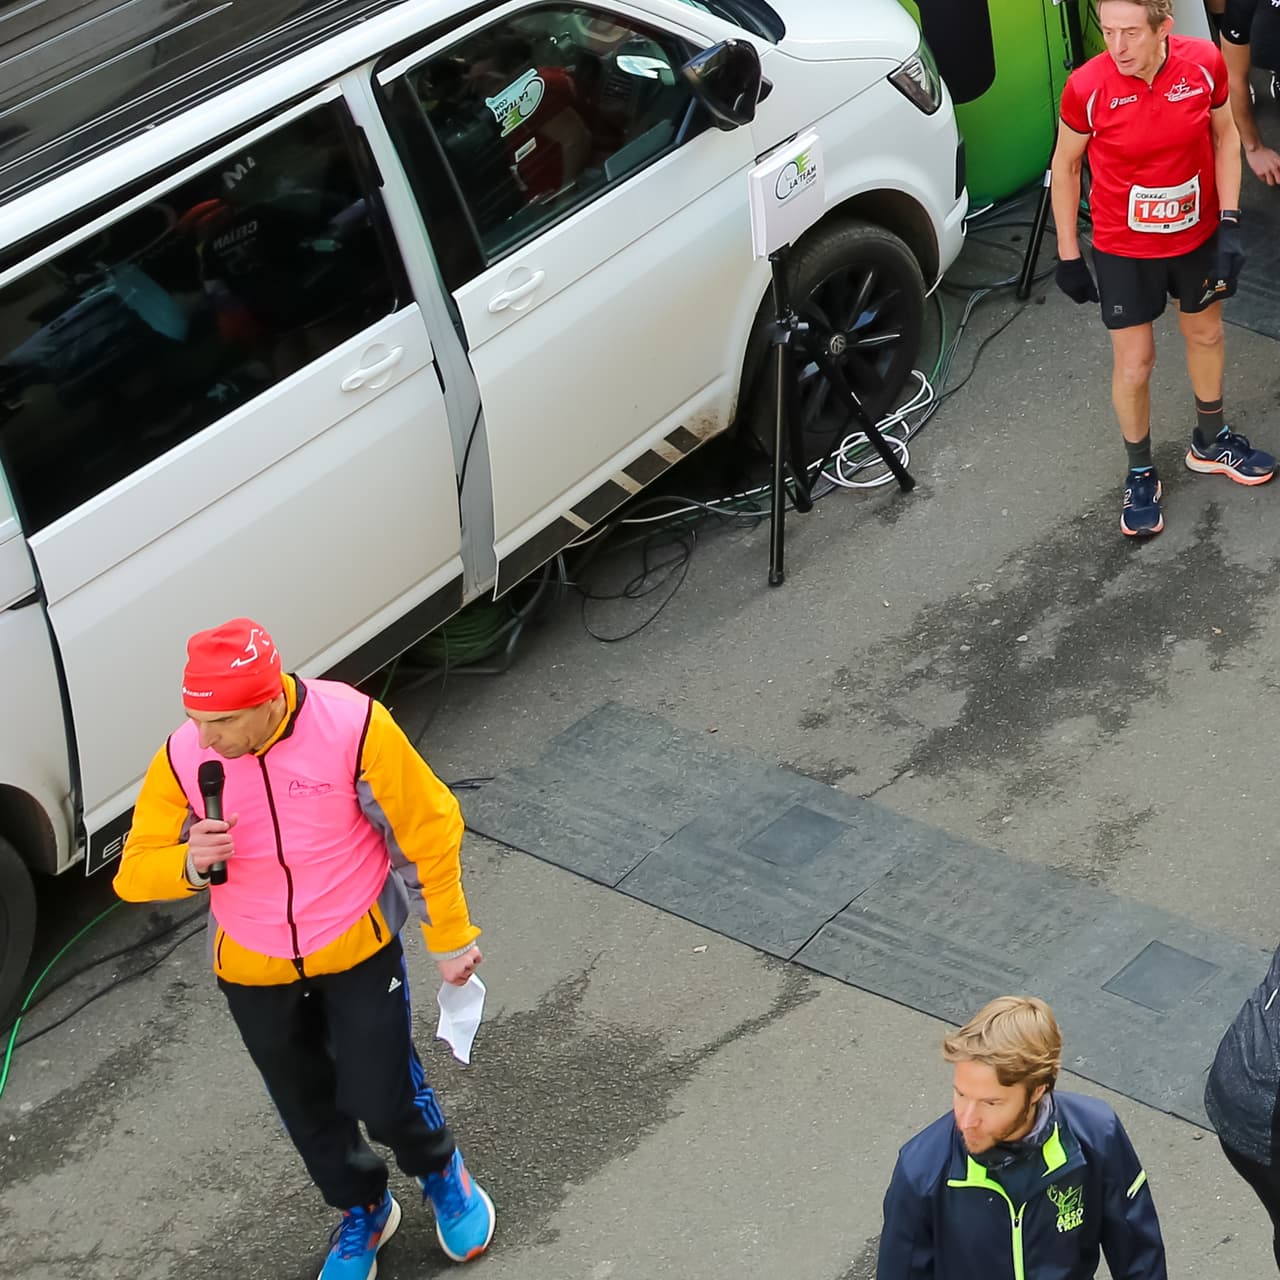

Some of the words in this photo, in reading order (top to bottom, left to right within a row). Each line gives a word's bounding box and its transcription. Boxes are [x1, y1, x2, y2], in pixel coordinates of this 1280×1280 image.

[789, 164, 817, 190] LA'TEAM
[1140, 201, 1179, 219] 140
[1056, 1208, 1084, 1224] ASSO
[1056, 1219, 1083, 1233] TRAIL
